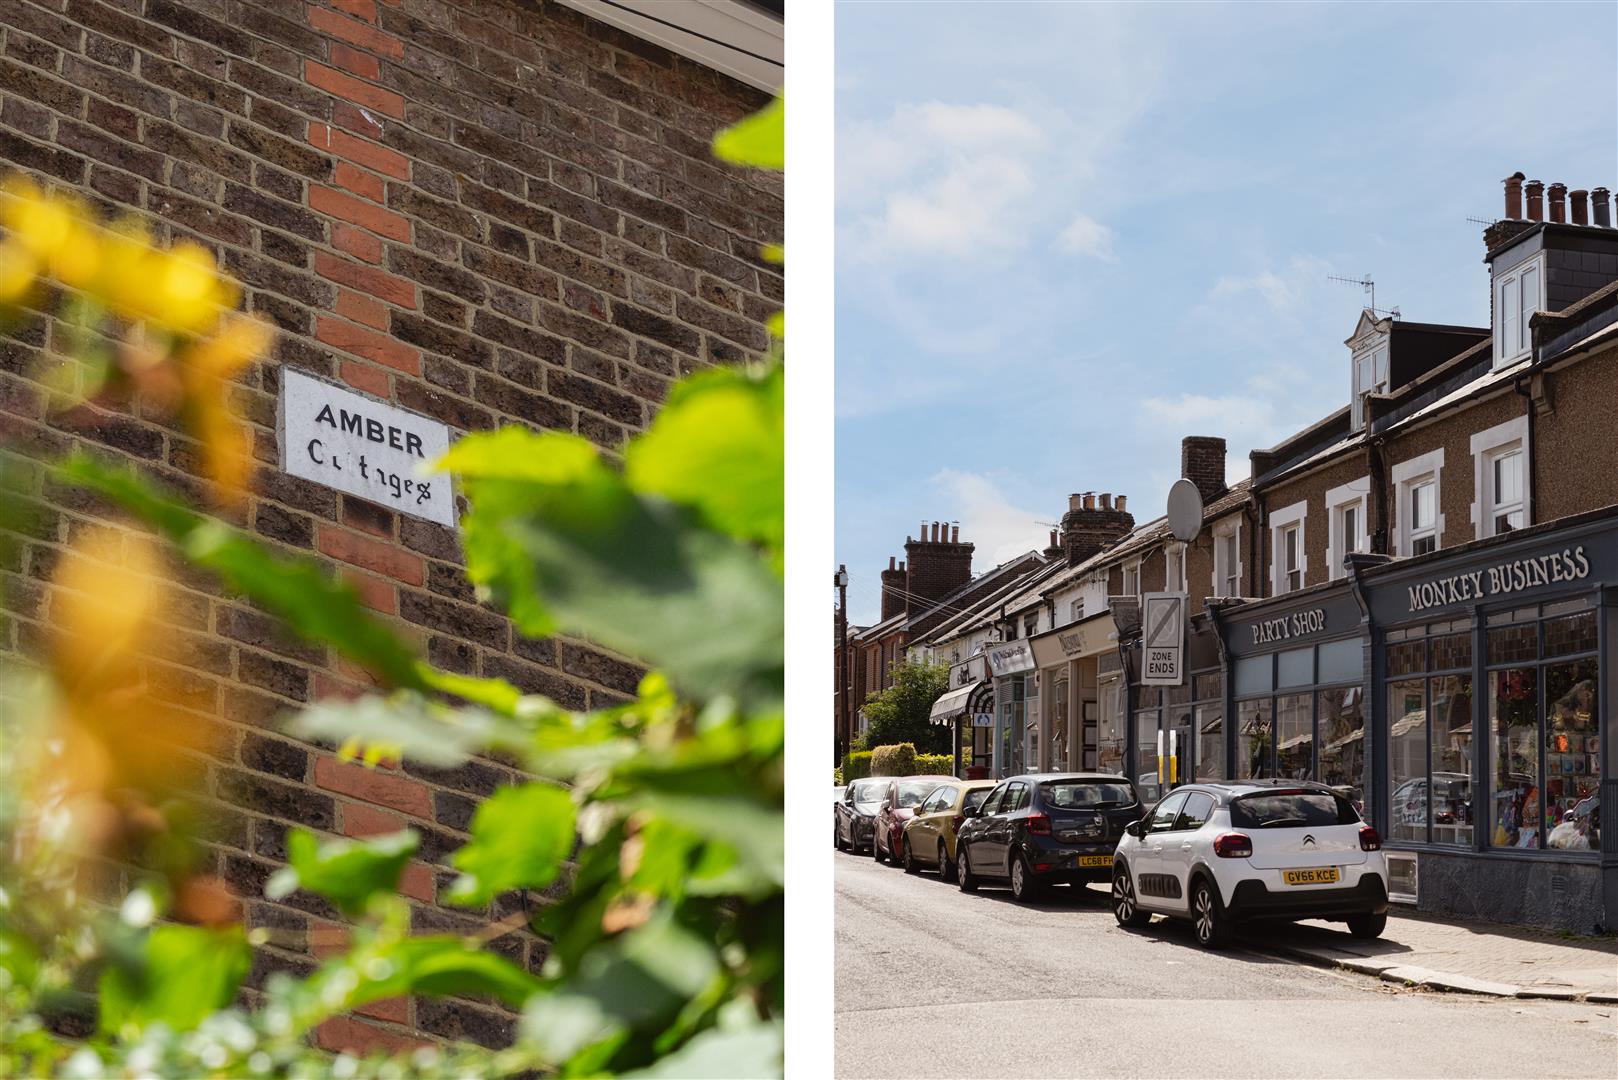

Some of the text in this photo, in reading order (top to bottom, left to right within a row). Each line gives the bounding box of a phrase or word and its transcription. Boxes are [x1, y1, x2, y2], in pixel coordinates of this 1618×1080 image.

[315, 404, 425, 458] AMBER
[1408, 546, 1589, 612] MONKEY BUSINESS
[1252, 609, 1324, 644] PARTY SHOP
[1149, 663, 1175, 673] ENDS
[1152, 652, 1172, 661] ZONE
[1288, 870, 1336, 882] GV66 KCE
